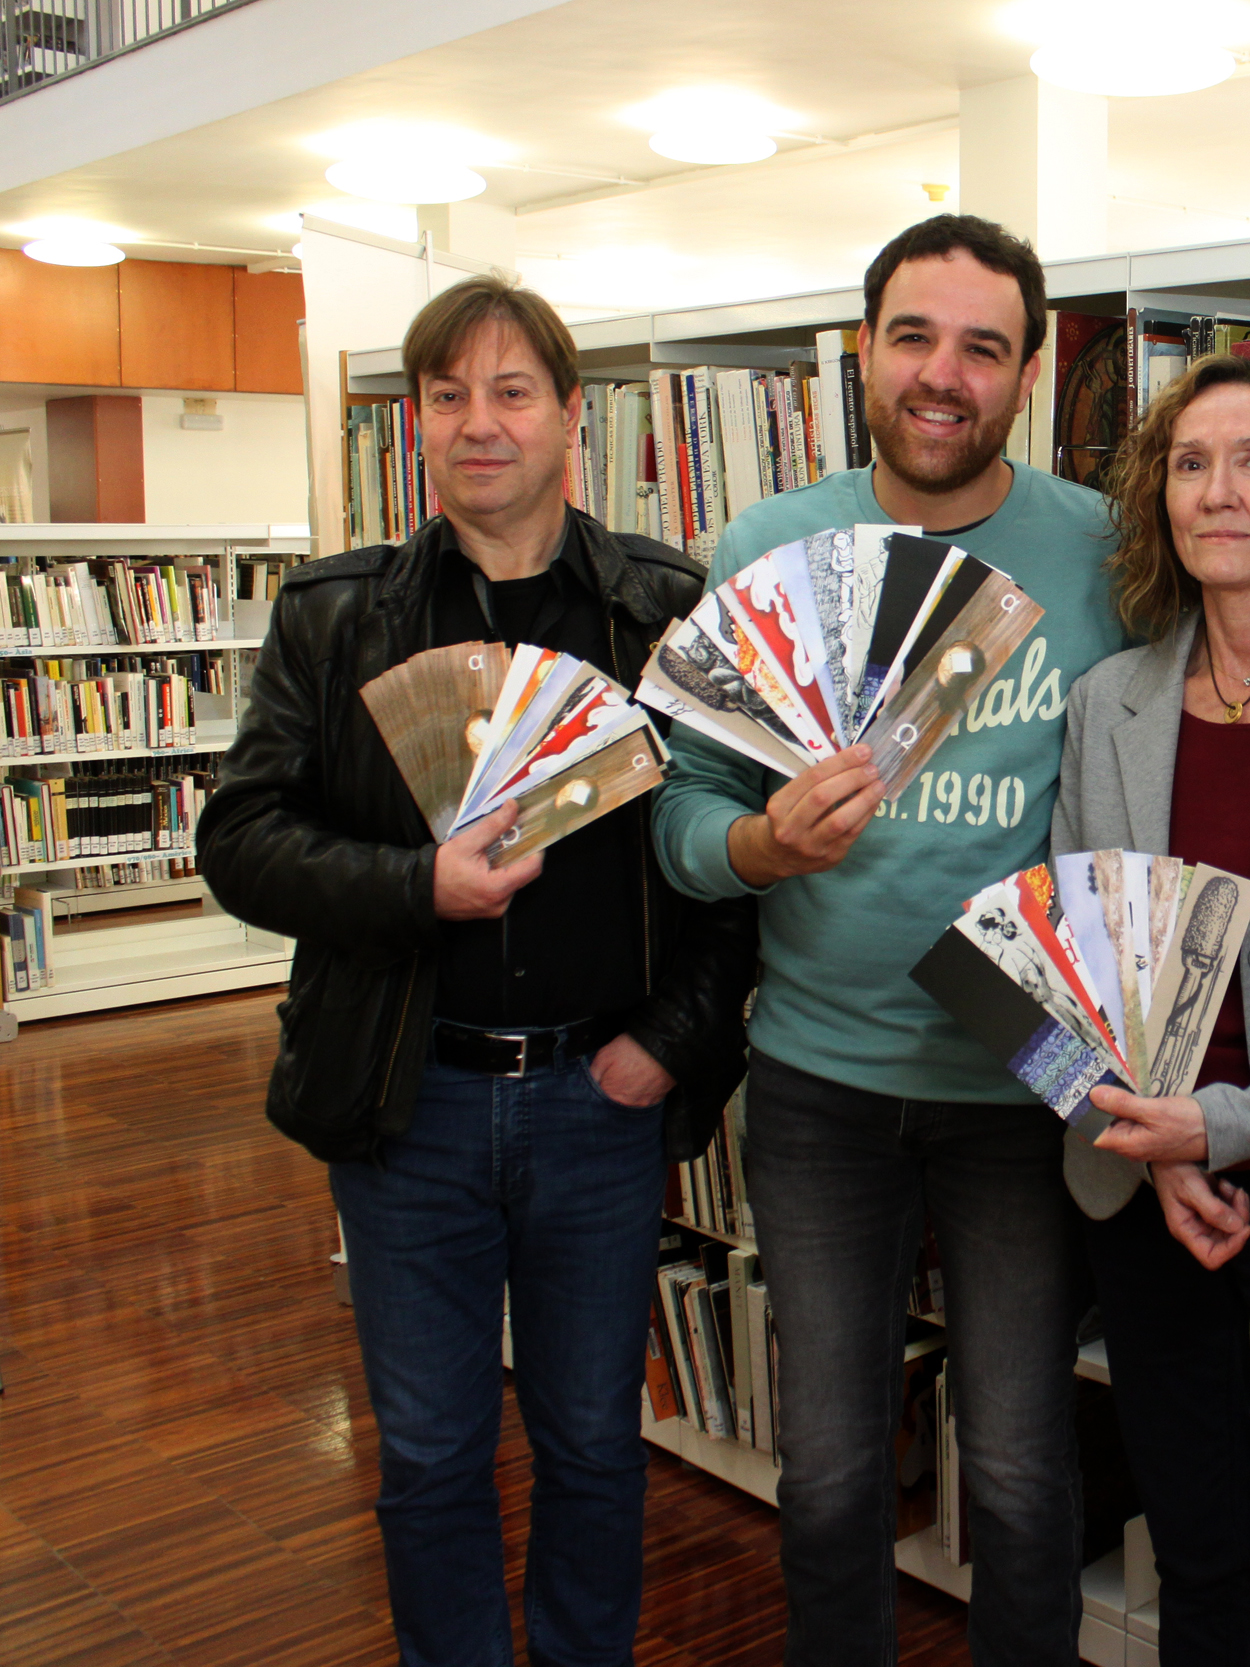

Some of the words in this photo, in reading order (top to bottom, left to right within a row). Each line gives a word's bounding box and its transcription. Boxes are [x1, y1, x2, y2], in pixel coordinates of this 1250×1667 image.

[845, 369, 855, 378] El
[846, 380, 854, 412] retrato
[698, 411, 708, 445] YORK
[794, 415, 802, 451] PINTURA
[807, 421, 817, 457] artista
[847, 414, 859, 448] español
[656, 440, 666, 484] PRADO
[693, 437, 703, 493] D'HIVERN
[701, 449, 711, 491] NUEVA
[775, 457, 784, 490] FORMA
[798, 455, 804, 465] DE
[657, 488, 669, 515] DEL
[704, 496, 713, 513] DE
[917, 771, 1025, 829] 1990
[656, 1383, 669, 1411] Klee
